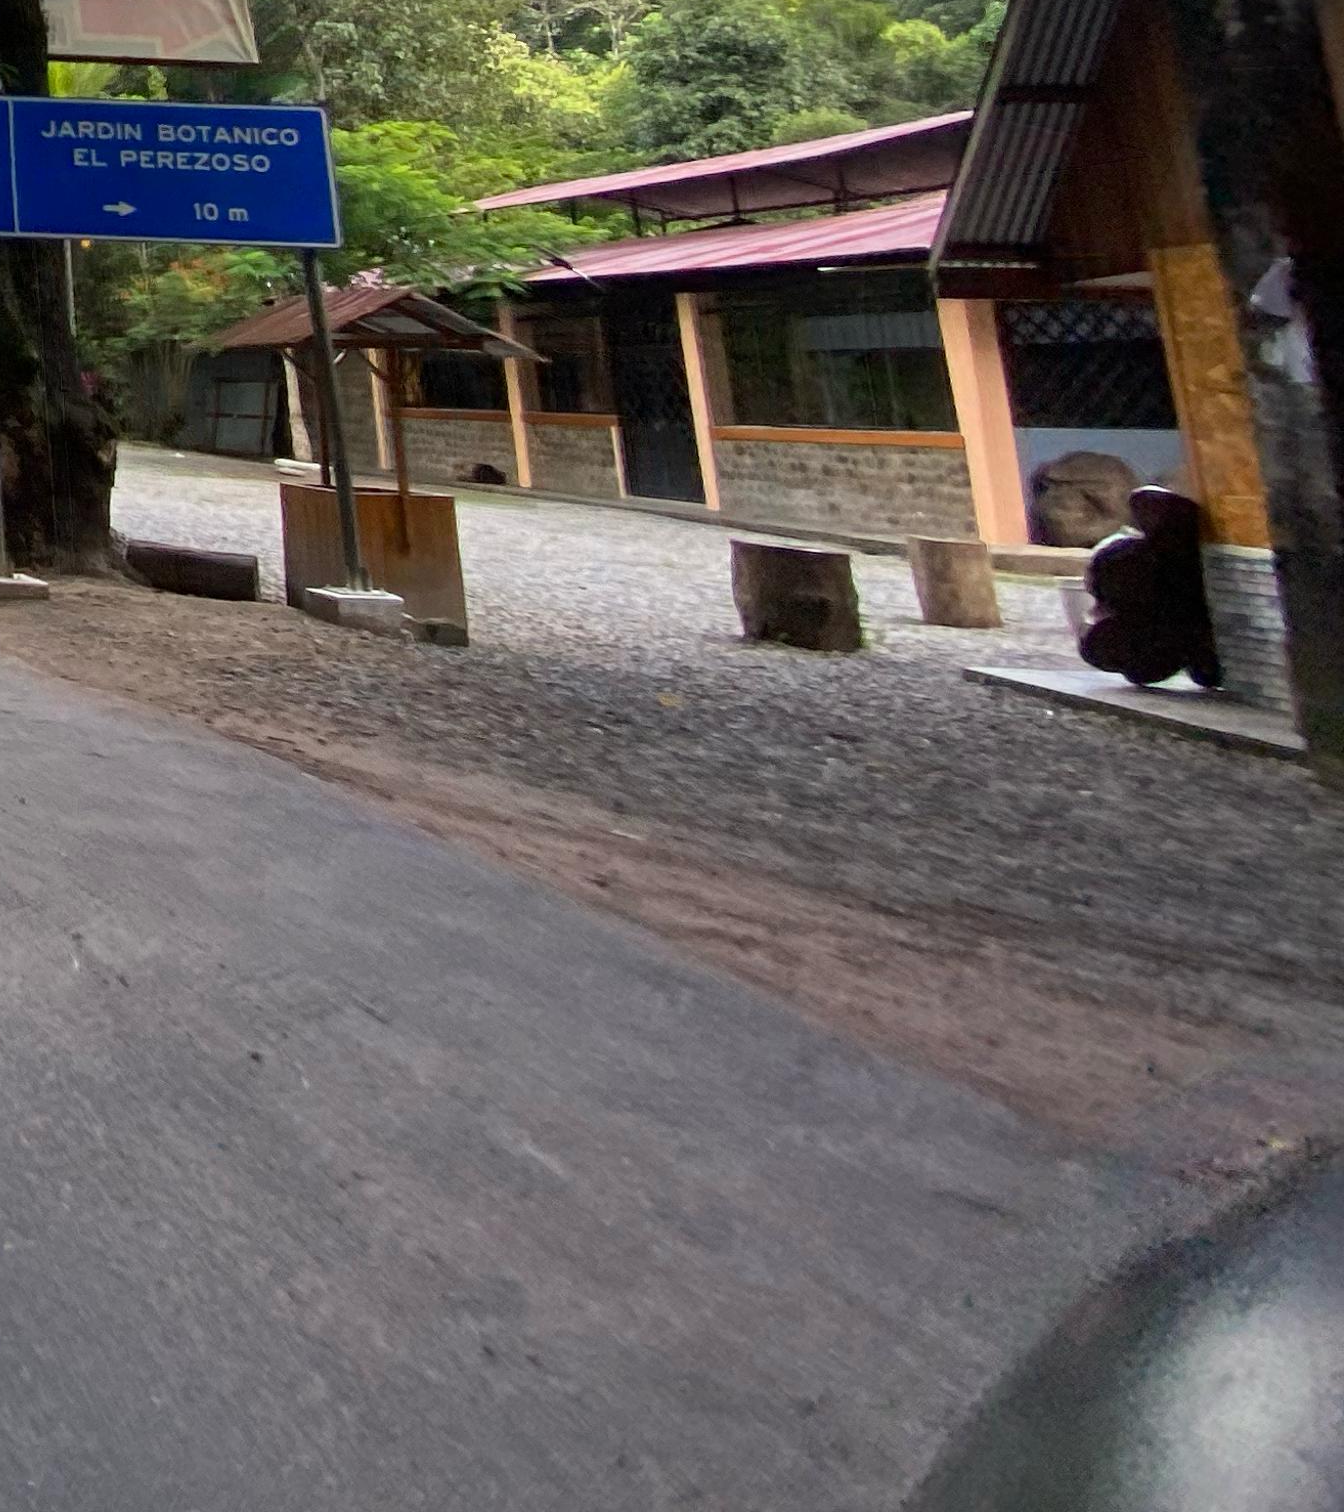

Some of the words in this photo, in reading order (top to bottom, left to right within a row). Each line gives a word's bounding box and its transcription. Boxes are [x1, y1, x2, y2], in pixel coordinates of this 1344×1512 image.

[40, 119, 143, 141] JARDIN
[157, 123, 300, 147] BOTANICO
[72, 147, 108, 167] EL
[119, 149, 271, 173] PEREZOSO
[193, 202, 220, 222] 10
[227, 207, 250, 223] m
